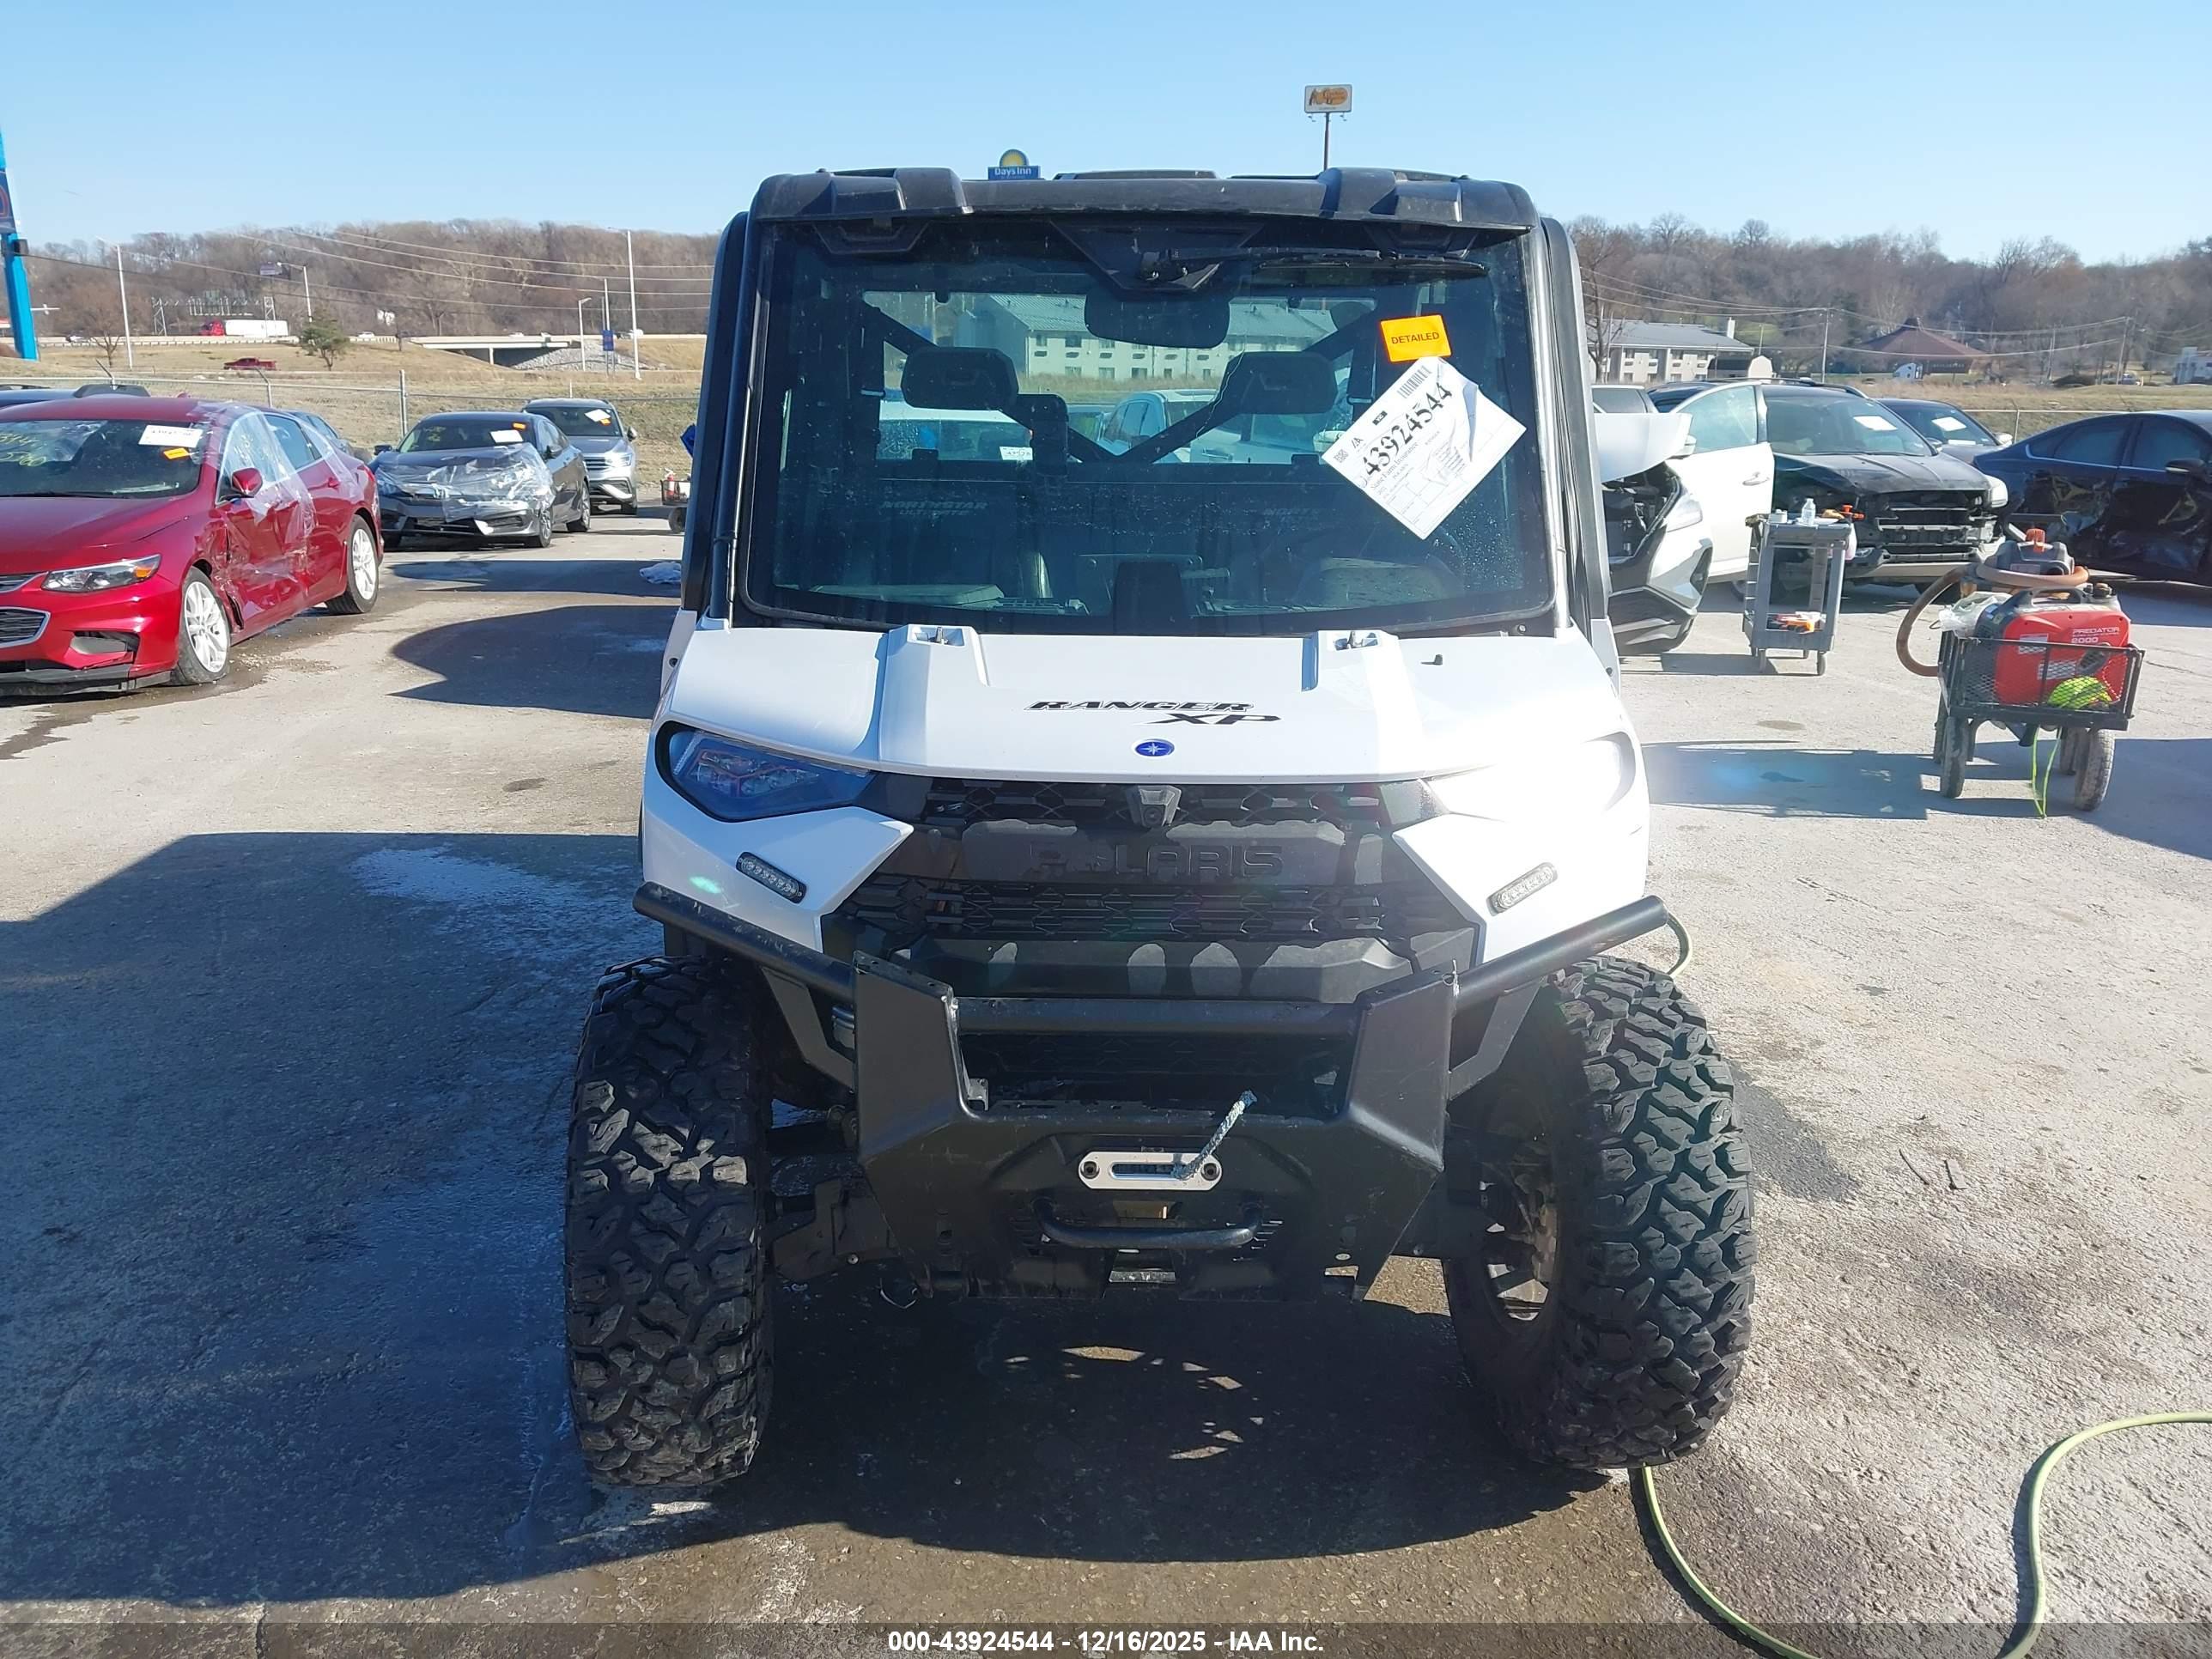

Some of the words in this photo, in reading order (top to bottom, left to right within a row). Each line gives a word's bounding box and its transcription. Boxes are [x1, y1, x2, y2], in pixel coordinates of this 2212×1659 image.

[994, 167, 1016, 177] Days
[1391, 331, 1440, 344] DETAILED
[1363, 382, 1453, 476] 43924544
[1024, 701, 1254, 712] RANGER
[1140, 713, 1281, 725] XP
